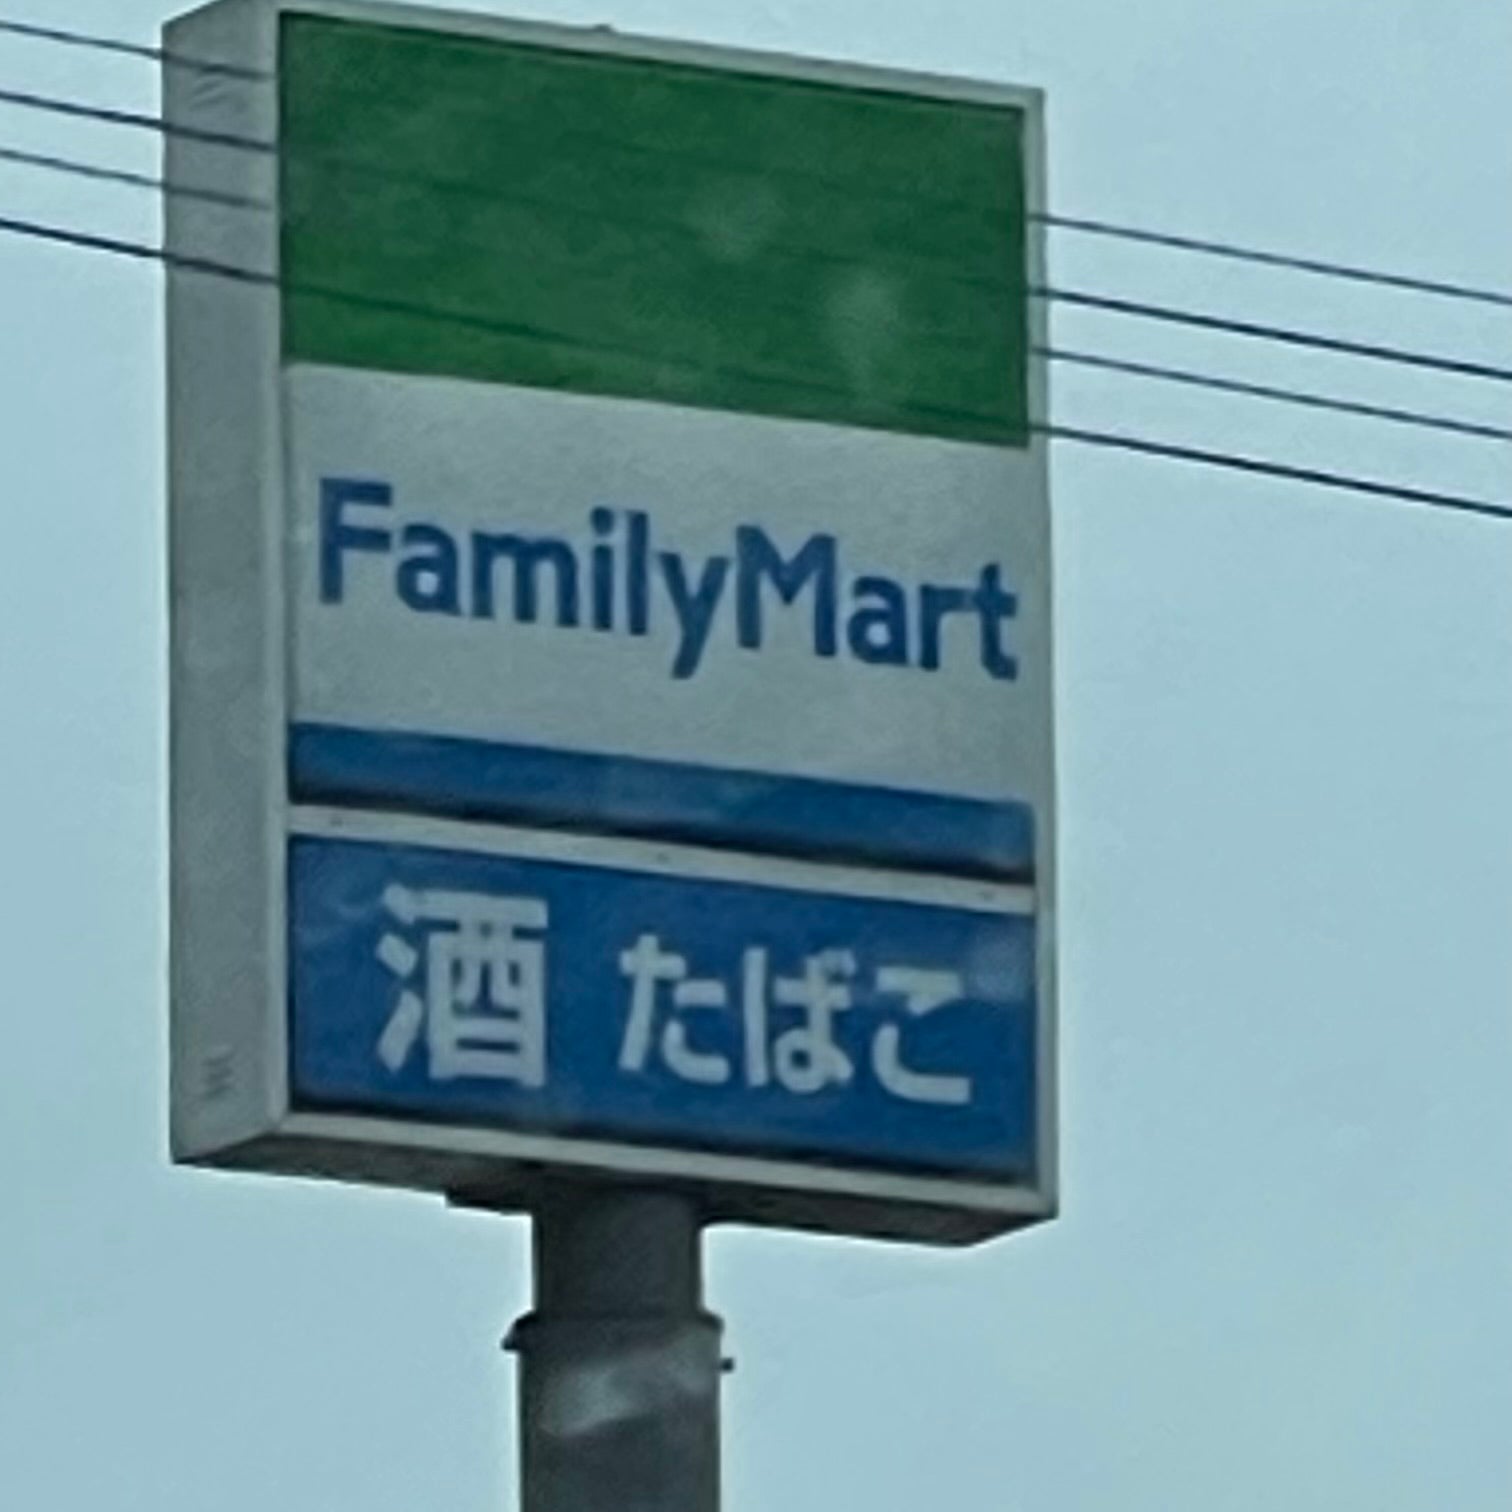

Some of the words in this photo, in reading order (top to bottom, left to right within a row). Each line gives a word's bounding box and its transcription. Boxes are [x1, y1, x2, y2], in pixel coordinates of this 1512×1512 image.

[317, 476, 1019, 682] FamilyMart
[375, 882, 549, 1089] 酒
[616, 934, 972, 1106] たばこ
